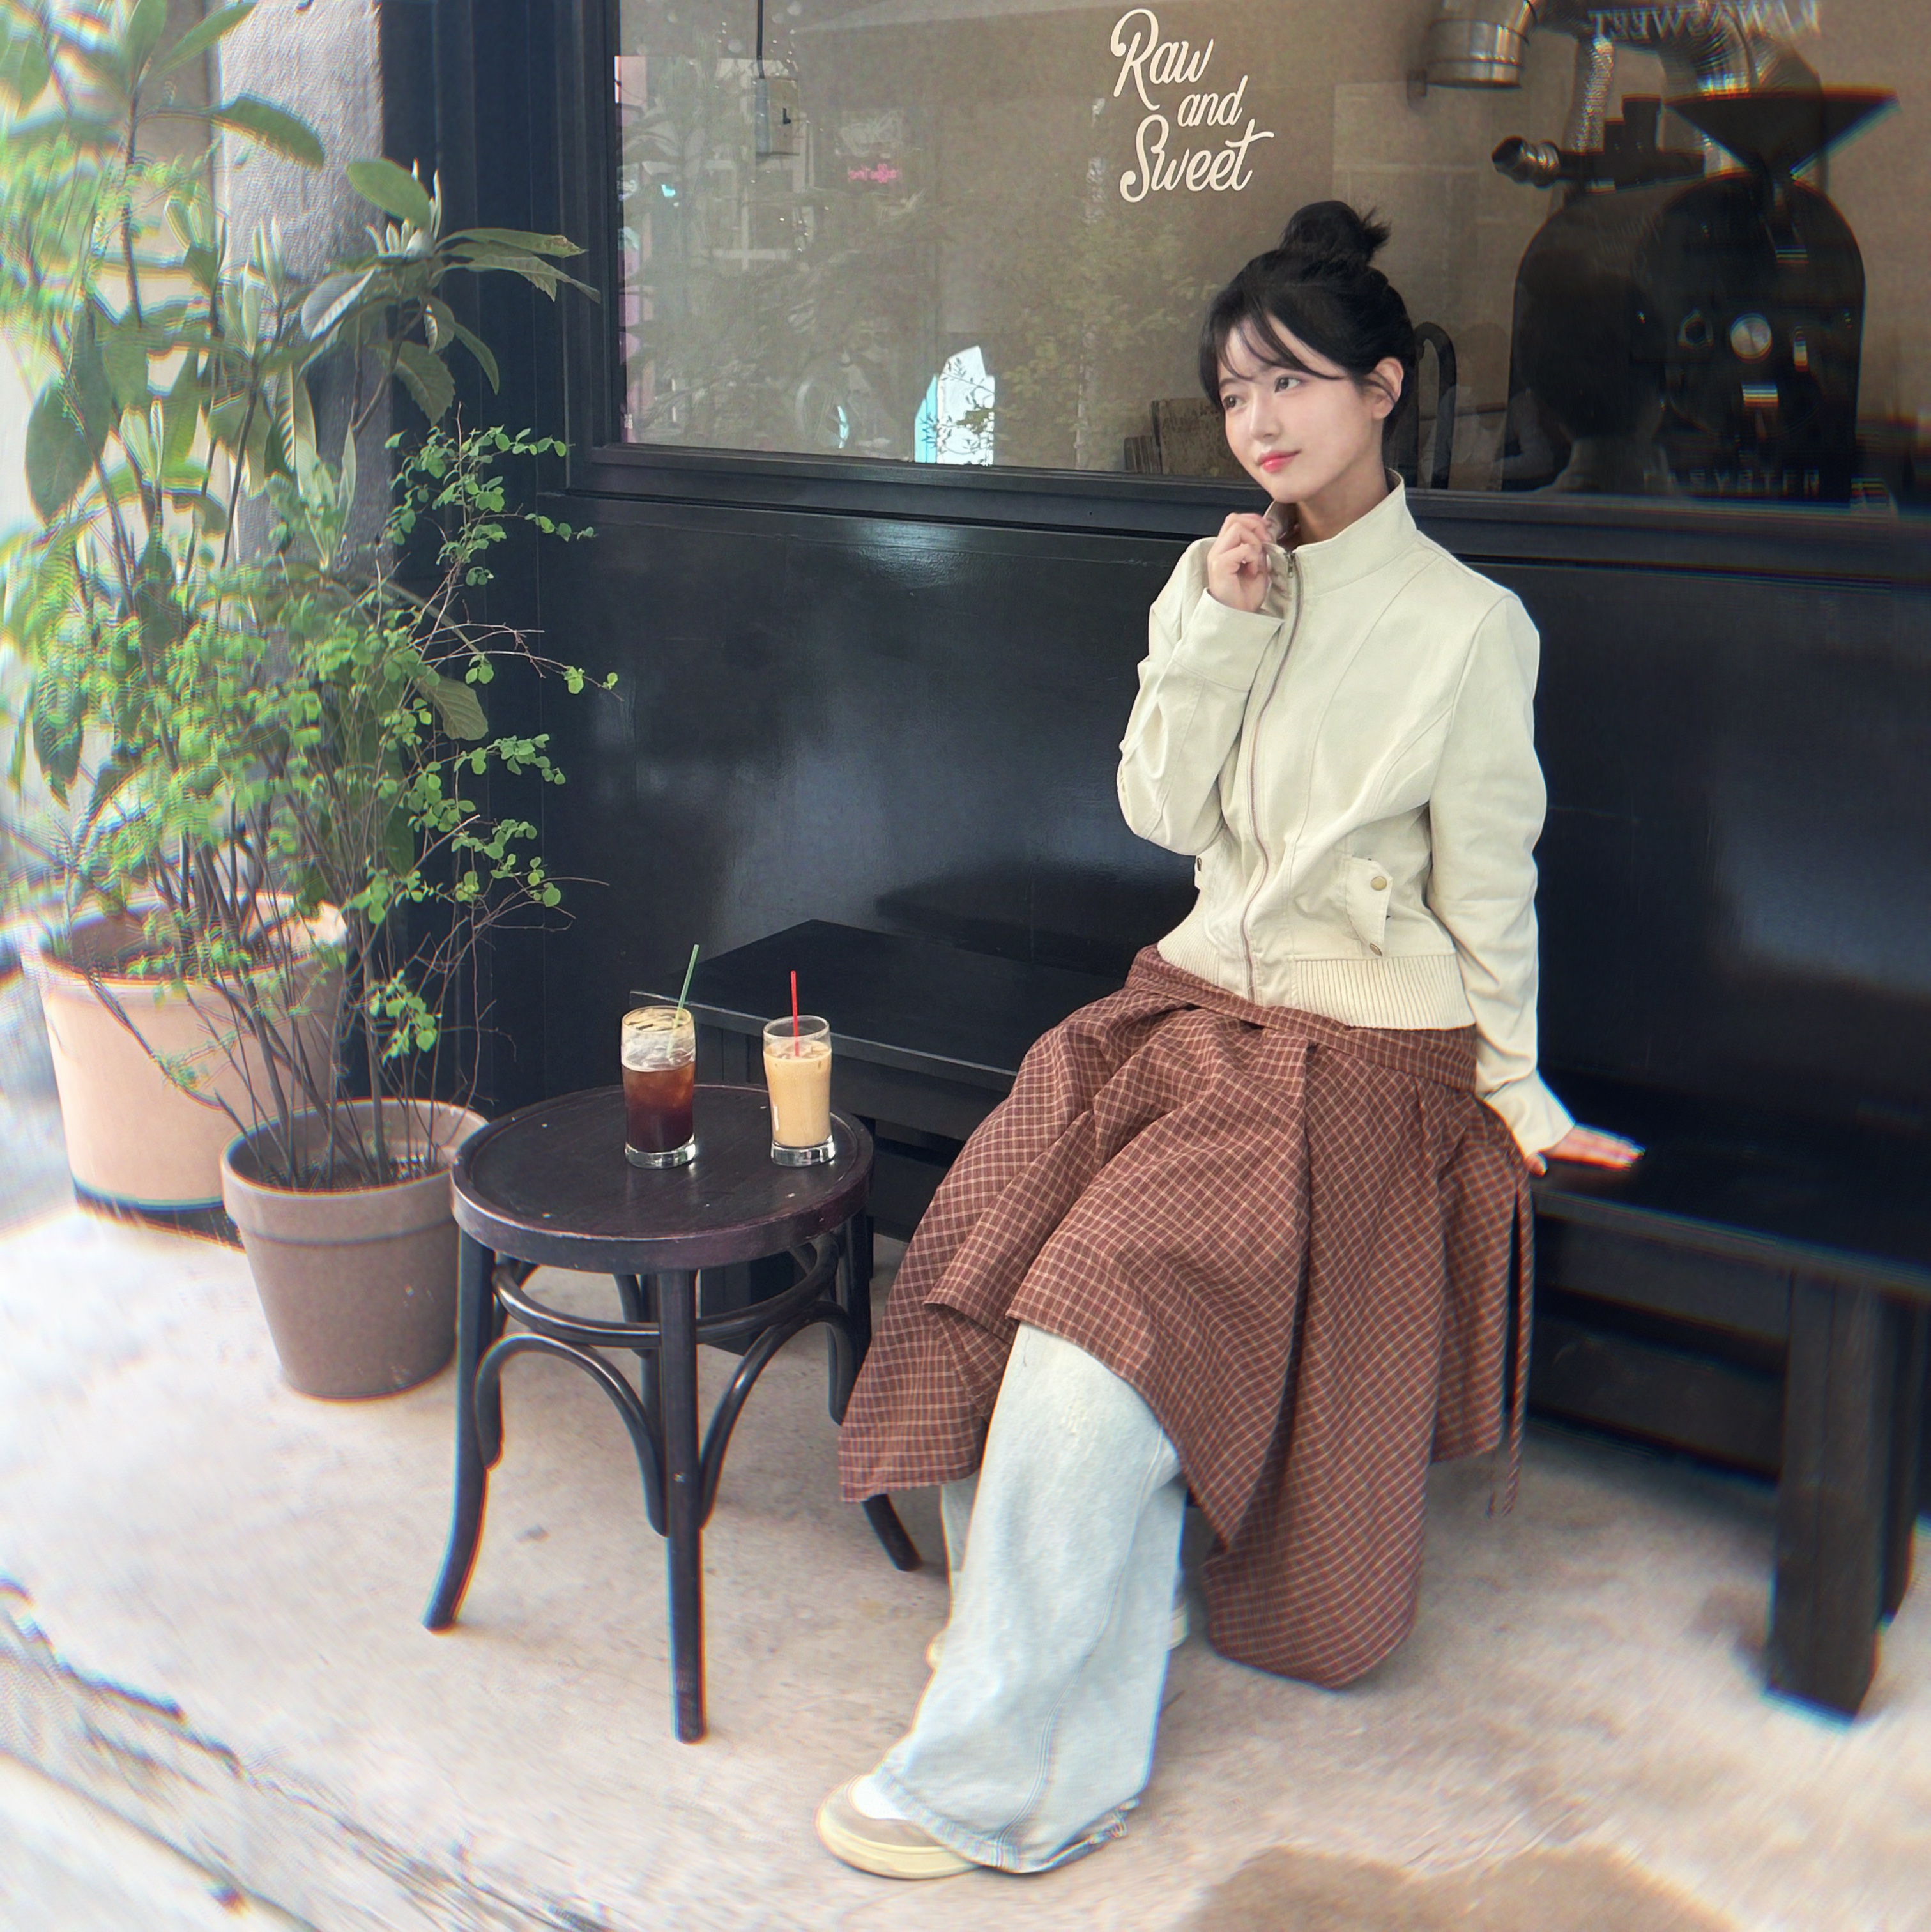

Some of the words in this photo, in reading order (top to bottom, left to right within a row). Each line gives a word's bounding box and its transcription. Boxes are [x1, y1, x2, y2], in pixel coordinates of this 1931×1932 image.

[1110, 8, 1214, 111] Raw
[1177, 75, 1248, 127] and
[1120, 114, 1274, 203] Sweet
